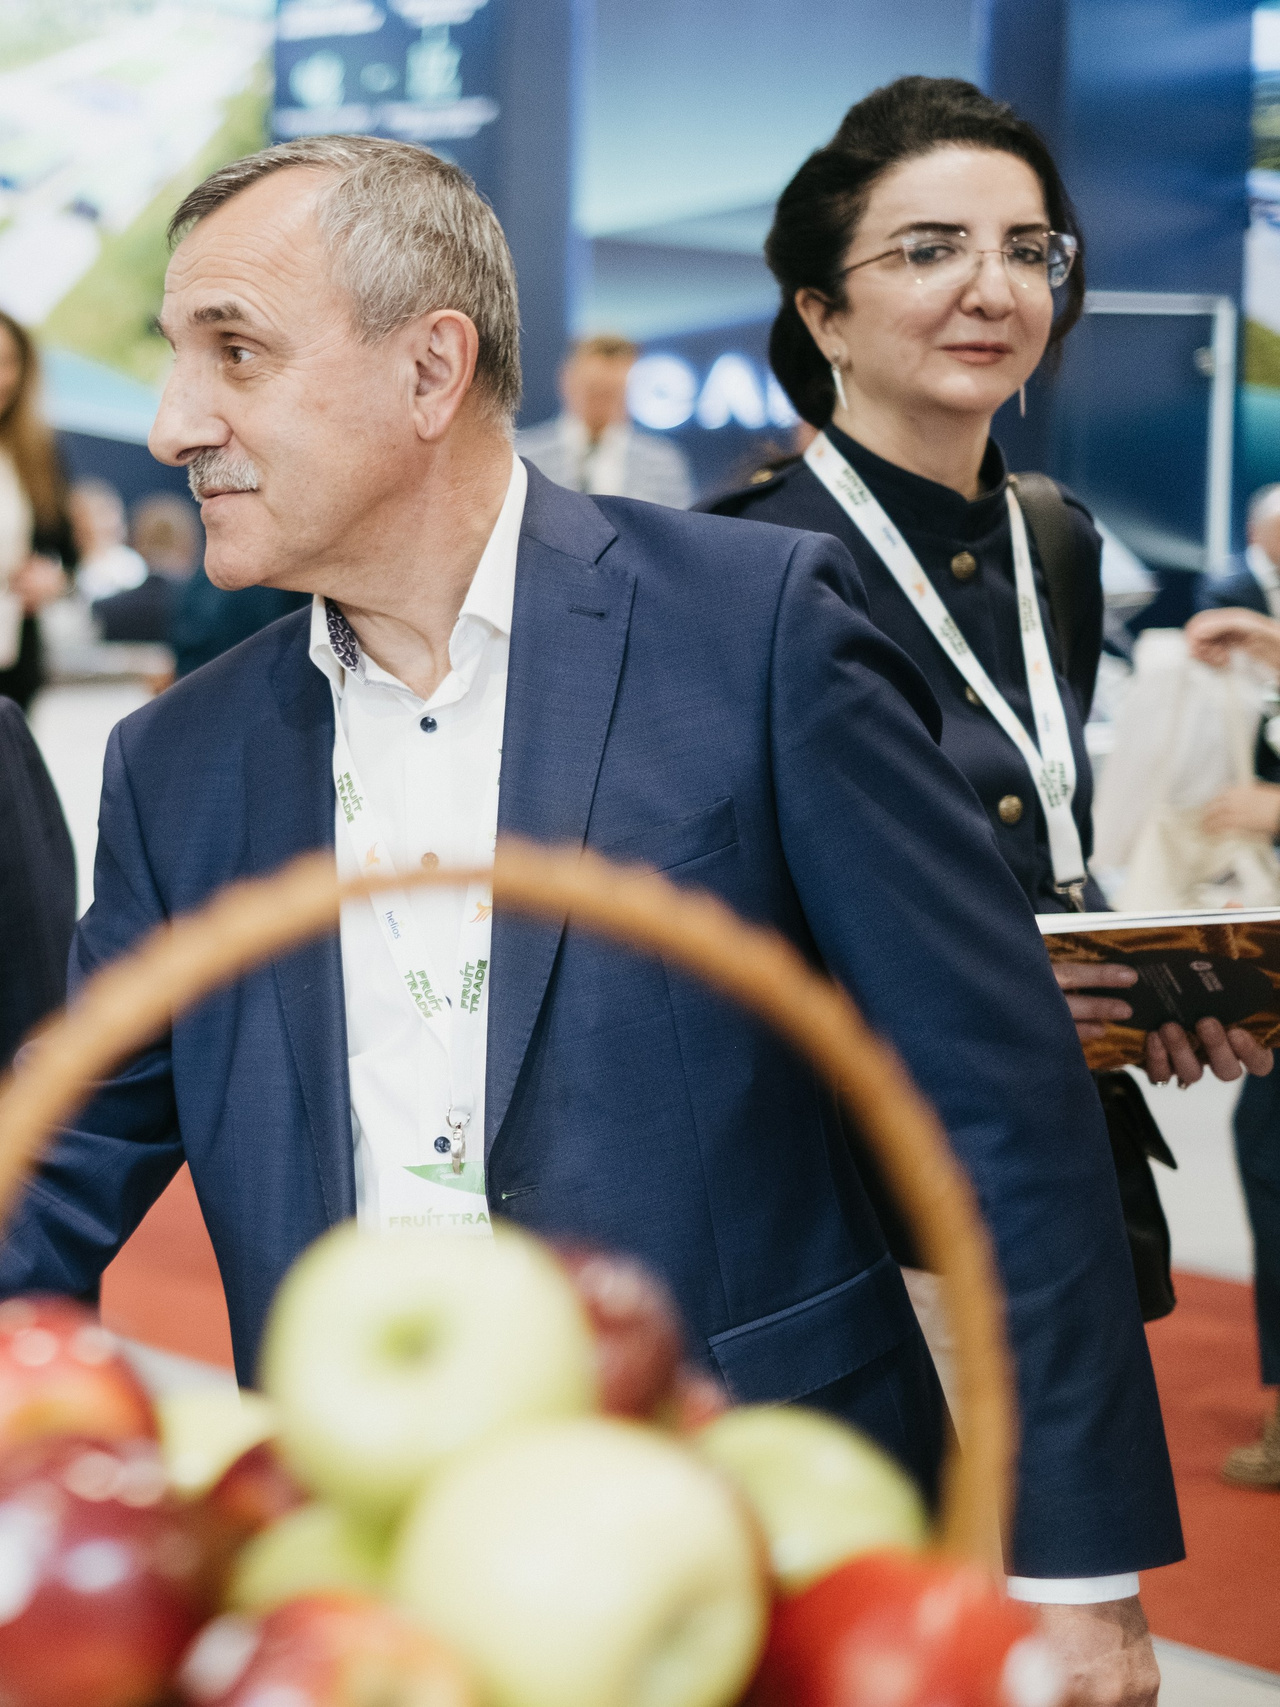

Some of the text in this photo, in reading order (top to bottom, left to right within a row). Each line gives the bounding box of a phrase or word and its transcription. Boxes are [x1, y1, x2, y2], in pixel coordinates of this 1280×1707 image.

[336, 774, 355, 823] TRADE
[385, 910, 401, 939] helios
[404, 970, 433, 1018] TRADE
[469, 959, 487, 1014] TRADE
[448, 1211, 490, 1226] TRA
